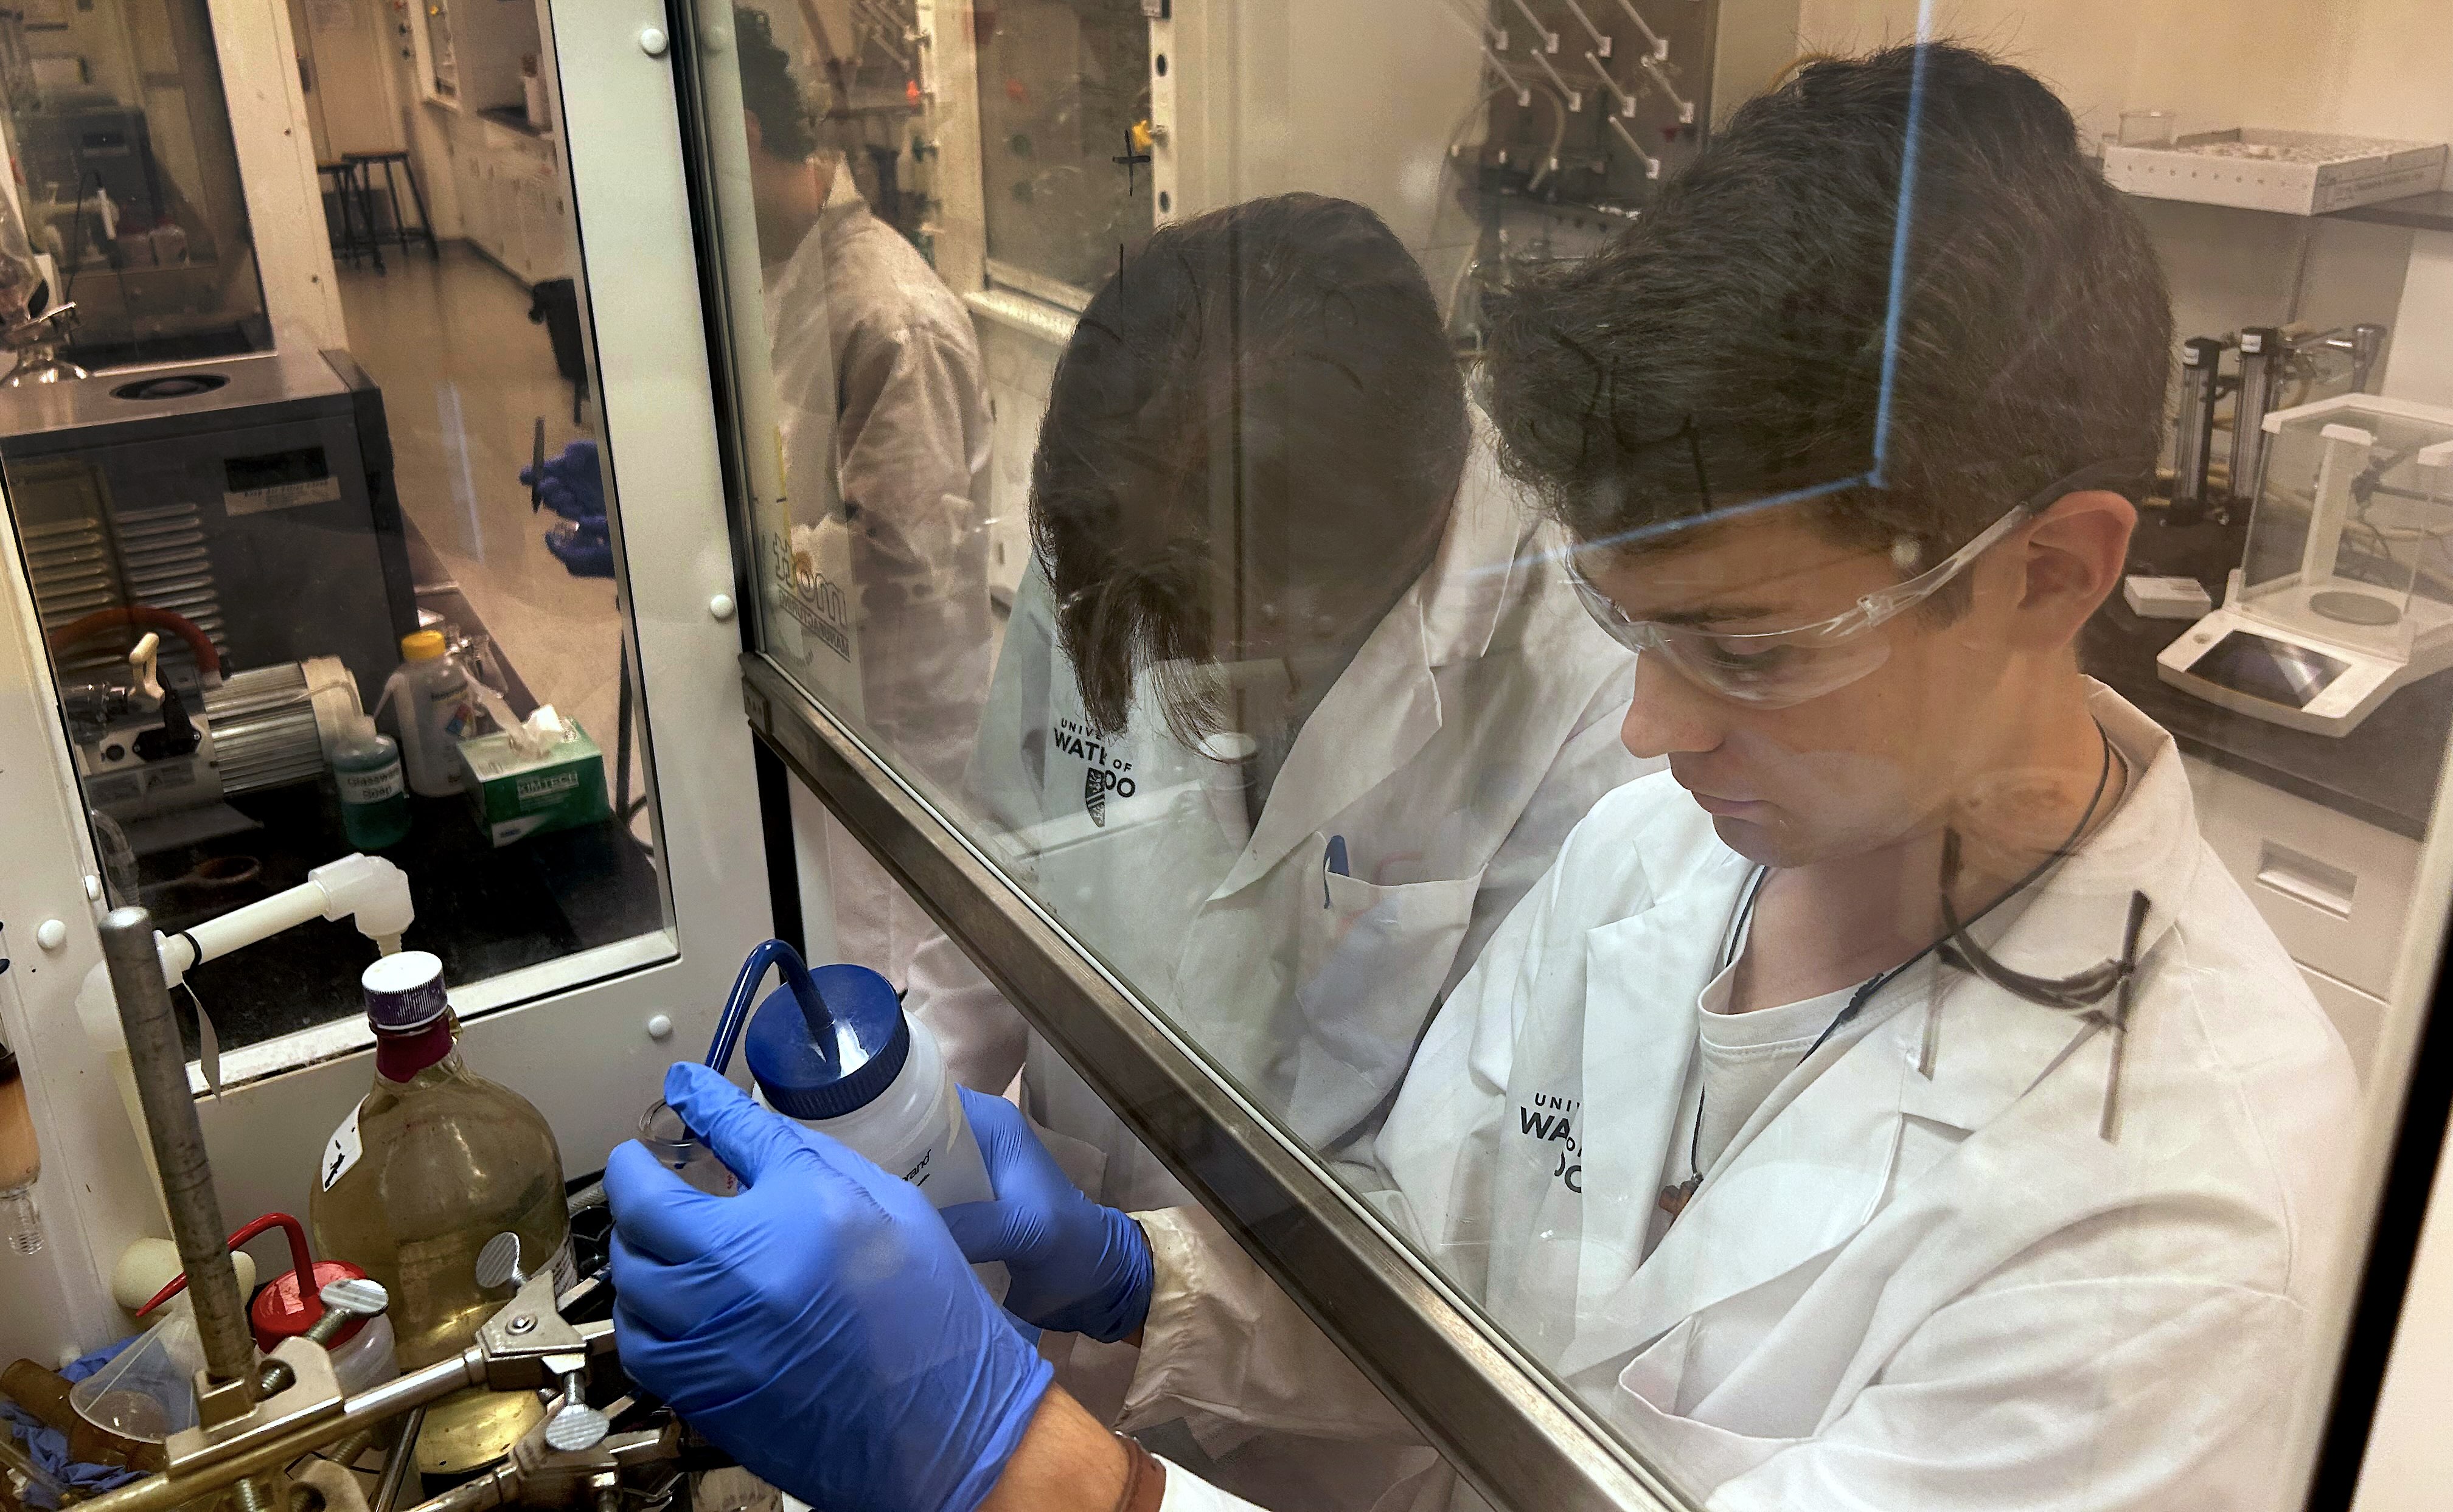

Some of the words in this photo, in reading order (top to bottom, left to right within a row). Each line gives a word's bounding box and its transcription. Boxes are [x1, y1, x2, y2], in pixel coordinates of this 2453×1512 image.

[1112, 758, 1132, 772] OF
[1534, 1092, 1581, 1112] UNI
[1565, 1136, 1582, 1157] O
